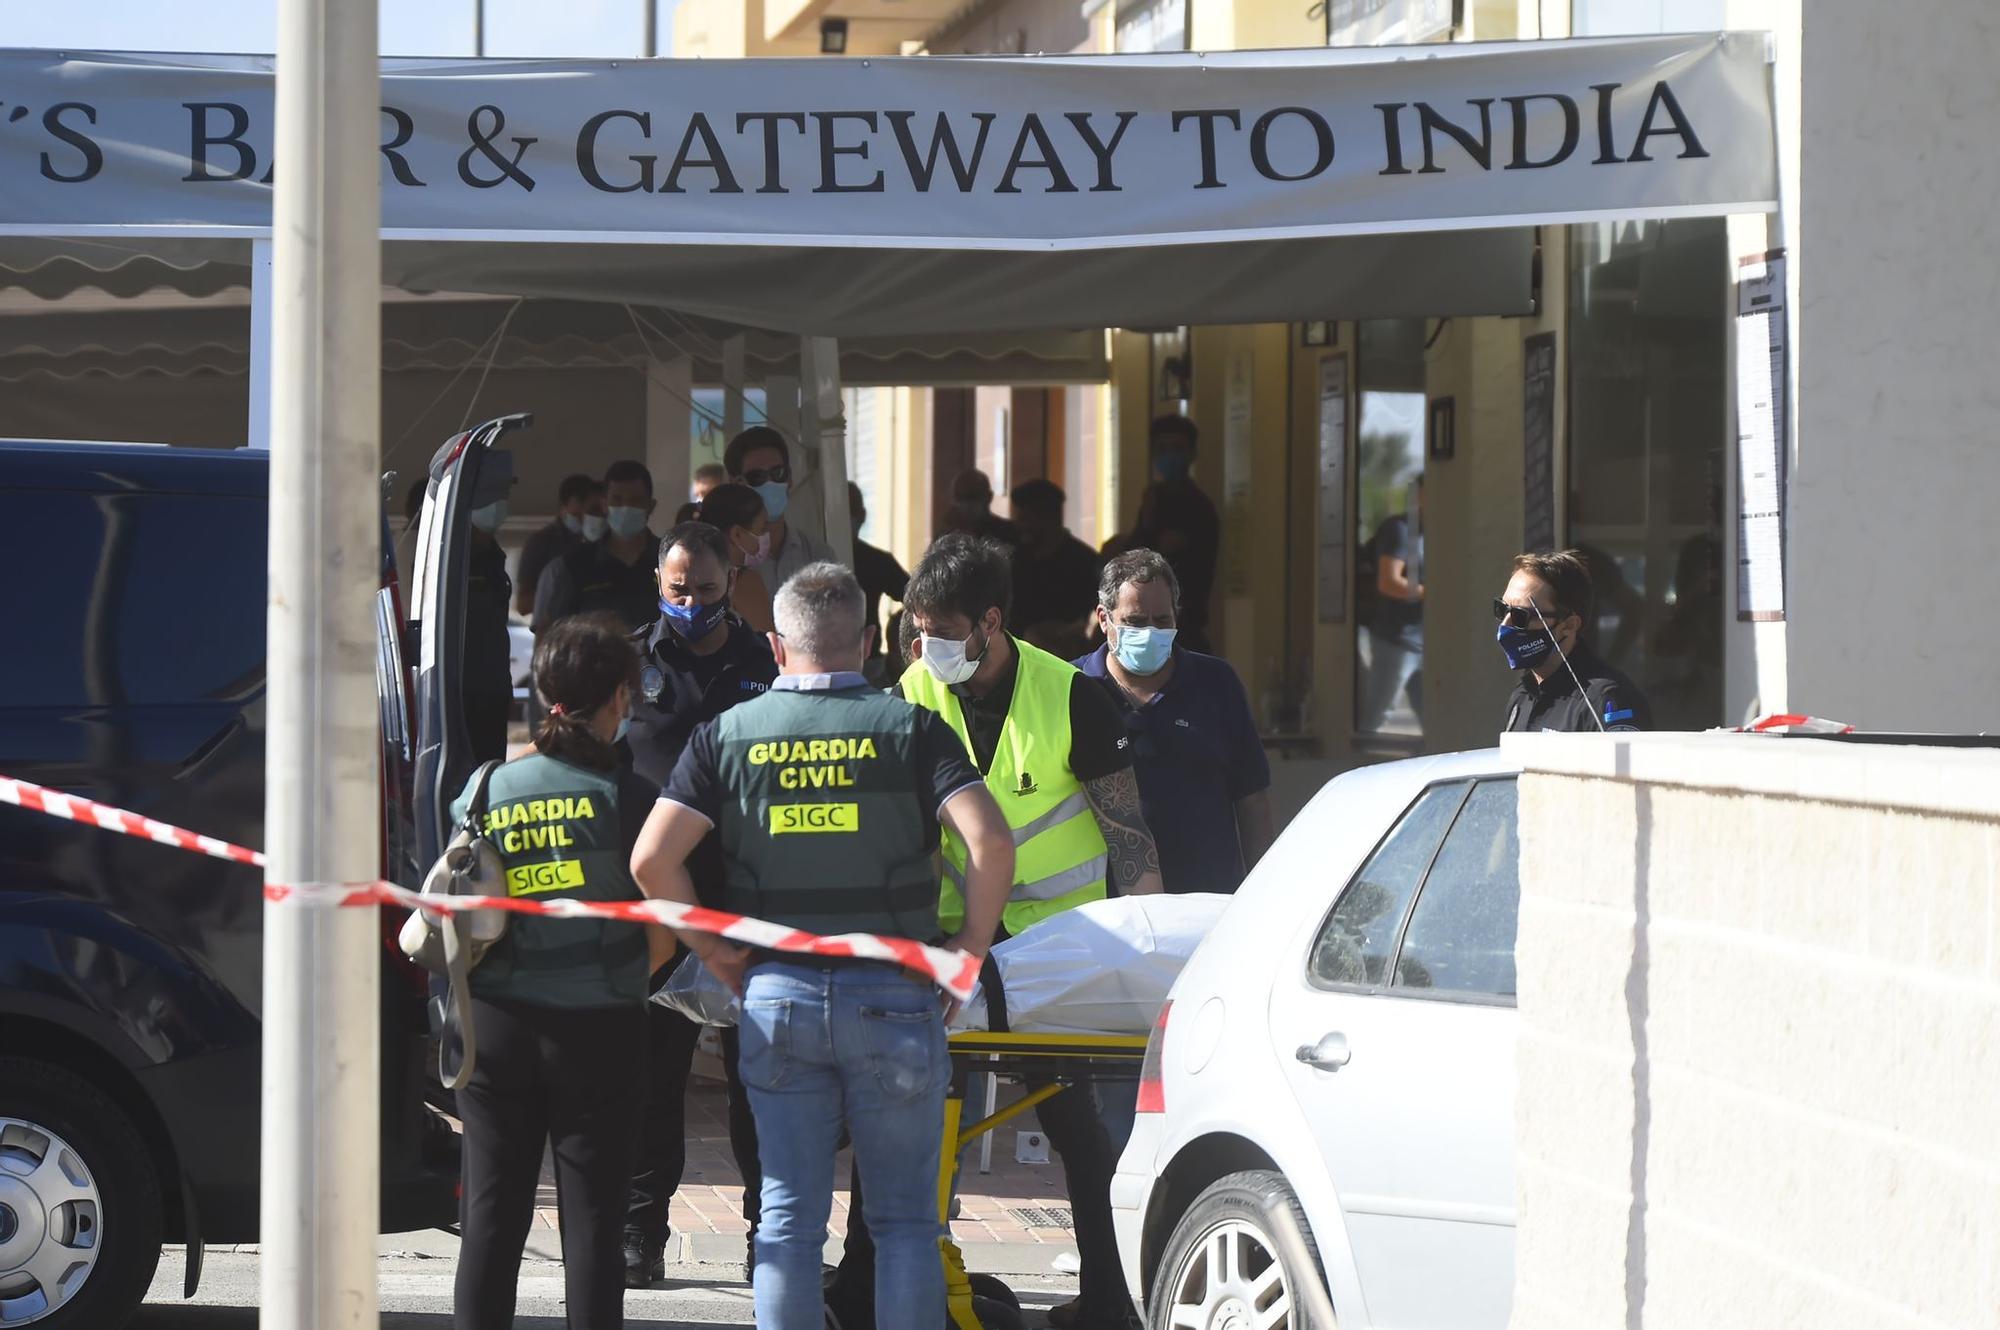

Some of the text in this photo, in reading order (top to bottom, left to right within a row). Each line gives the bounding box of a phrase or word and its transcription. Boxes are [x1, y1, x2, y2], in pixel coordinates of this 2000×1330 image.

[181, 102, 426, 187] BR
[457, 105, 538, 192] &
[575, 109, 1138, 194] GATEWAY
[1171, 106, 1336, 190] TO
[1373, 80, 1711, 176] INDIA
[748, 738, 877, 765] GUARDIA
[779, 765, 854, 789] CIVIL
[783, 806, 845, 828] SIGC
[503, 824, 574, 853] CIVIL
[513, 863, 570, 891] SIGC
